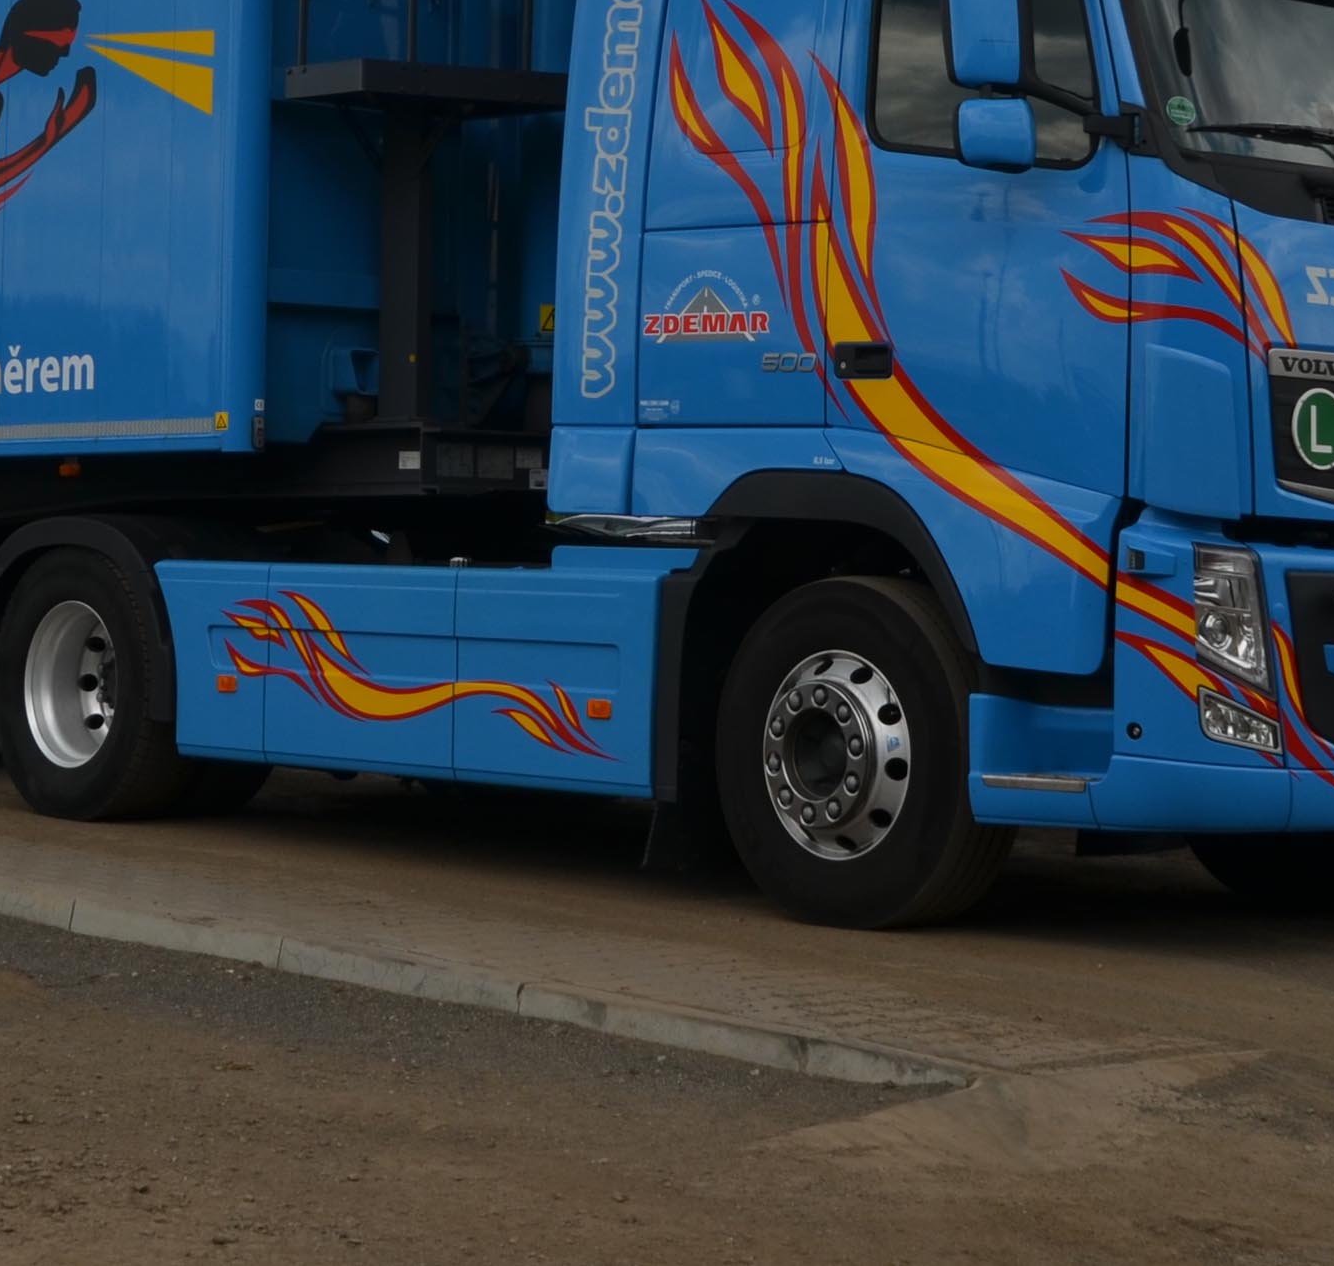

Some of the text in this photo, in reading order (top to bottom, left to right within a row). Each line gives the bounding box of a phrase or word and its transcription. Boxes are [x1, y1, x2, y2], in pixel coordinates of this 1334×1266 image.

[643, 311, 769, 335] ZDEMAR
[762, 352, 817, 373] 500
[1310, 404, 1333, 454] L
